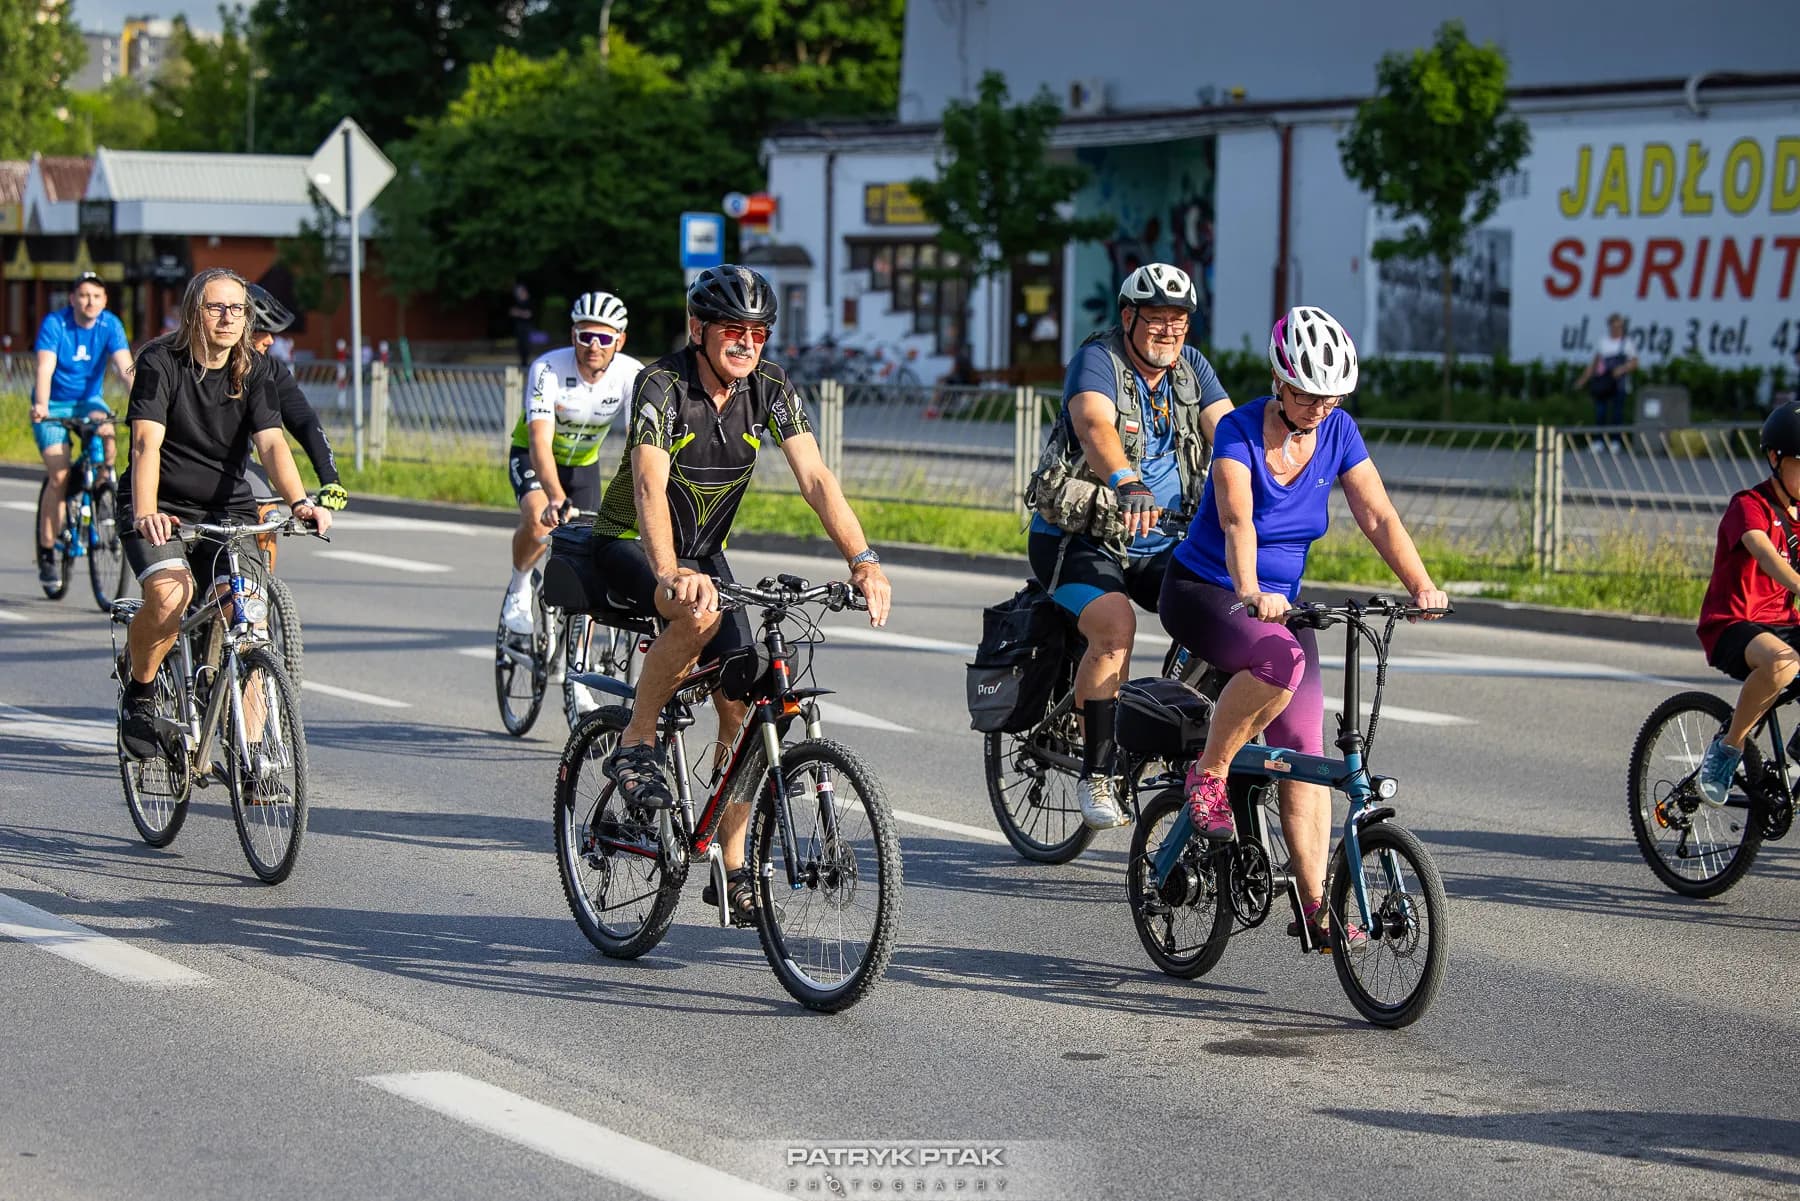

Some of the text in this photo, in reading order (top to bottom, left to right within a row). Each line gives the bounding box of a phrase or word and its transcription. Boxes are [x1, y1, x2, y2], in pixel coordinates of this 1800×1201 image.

[1558, 135, 1800, 218] JADŁOD
[1544, 235, 1800, 300] SPRINT
[1708, 316, 1751, 355] tel.
[752, 811, 767, 909] SCHWALBE
